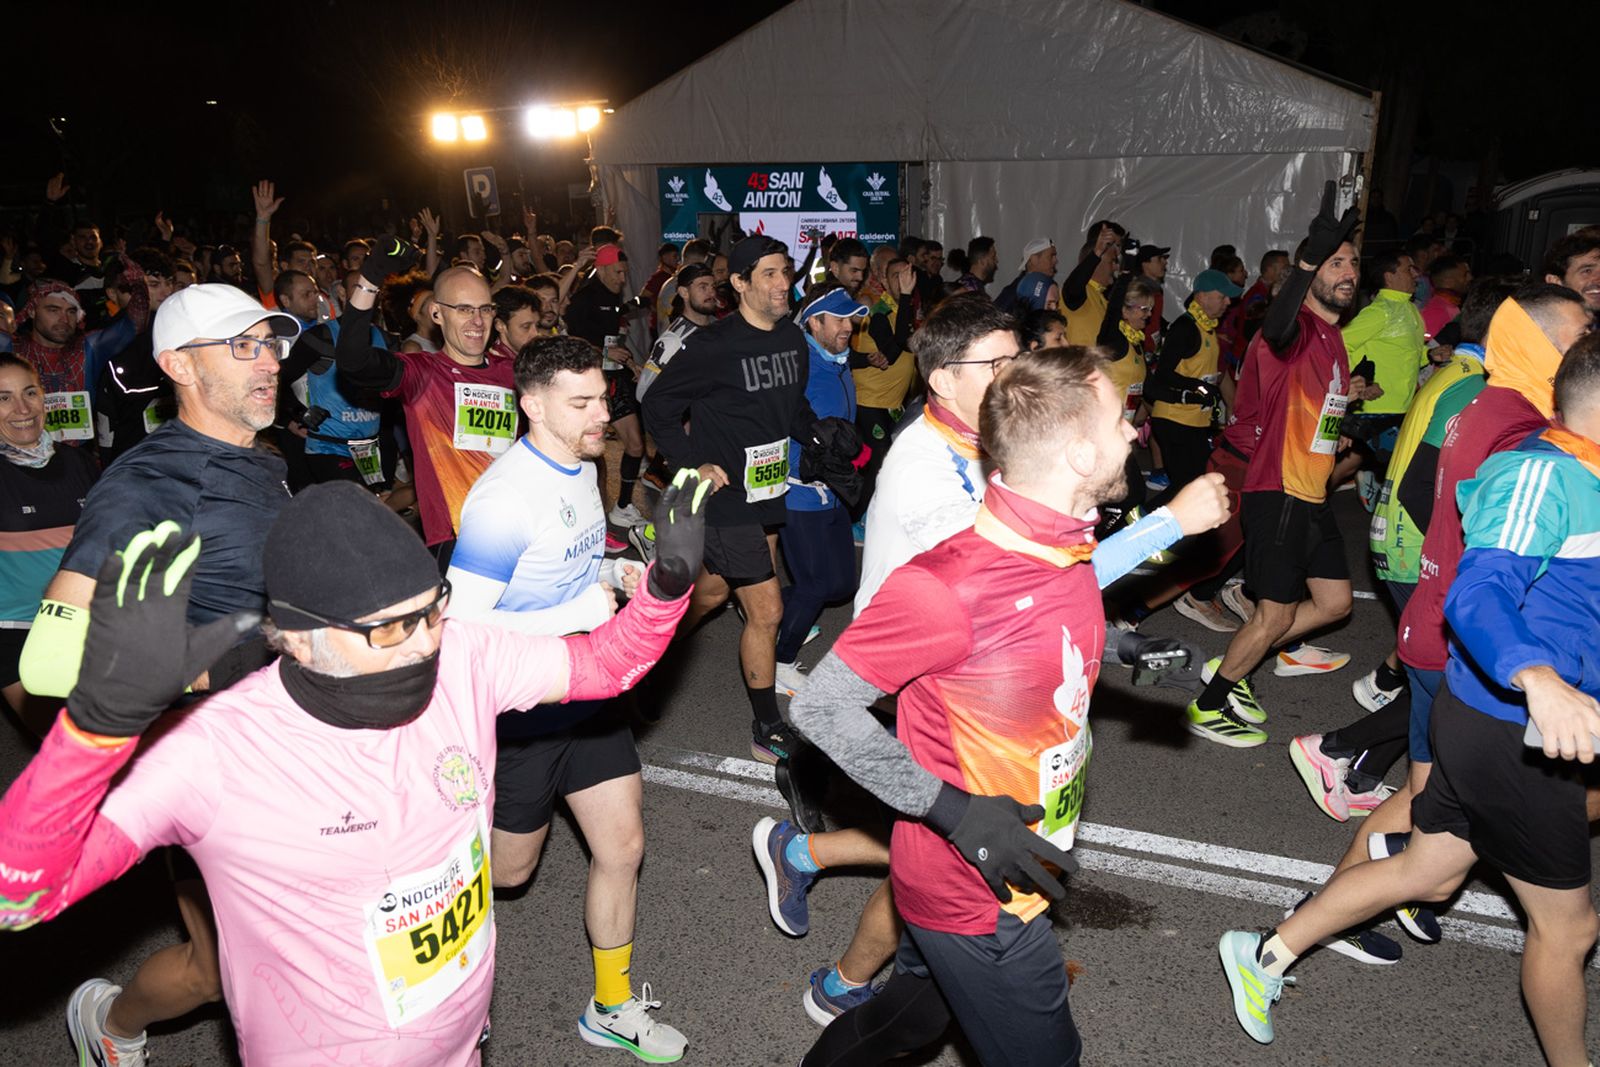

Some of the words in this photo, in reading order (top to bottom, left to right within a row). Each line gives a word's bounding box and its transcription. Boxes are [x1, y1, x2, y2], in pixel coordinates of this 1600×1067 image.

[712, 192, 723, 205] 43
[743, 186, 802, 208] ANTÓN
[826, 191, 838, 204] 43
[741, 350, 798, 392] USATF
[472, 391, 491, 399] NOCHE
[467, 408, 511, 431] 12074
[755, 459, 786, 483] 5550
[1051, 771, 1069, 788] SAN
[320, 820, 378, 836] TEAMERGY
[401, 877, 451, 909] NOCHE
[450, 859, 462, 884] DE
[385, 909, 420, 934] SAN
[409, 871, 484, 965] 5427
